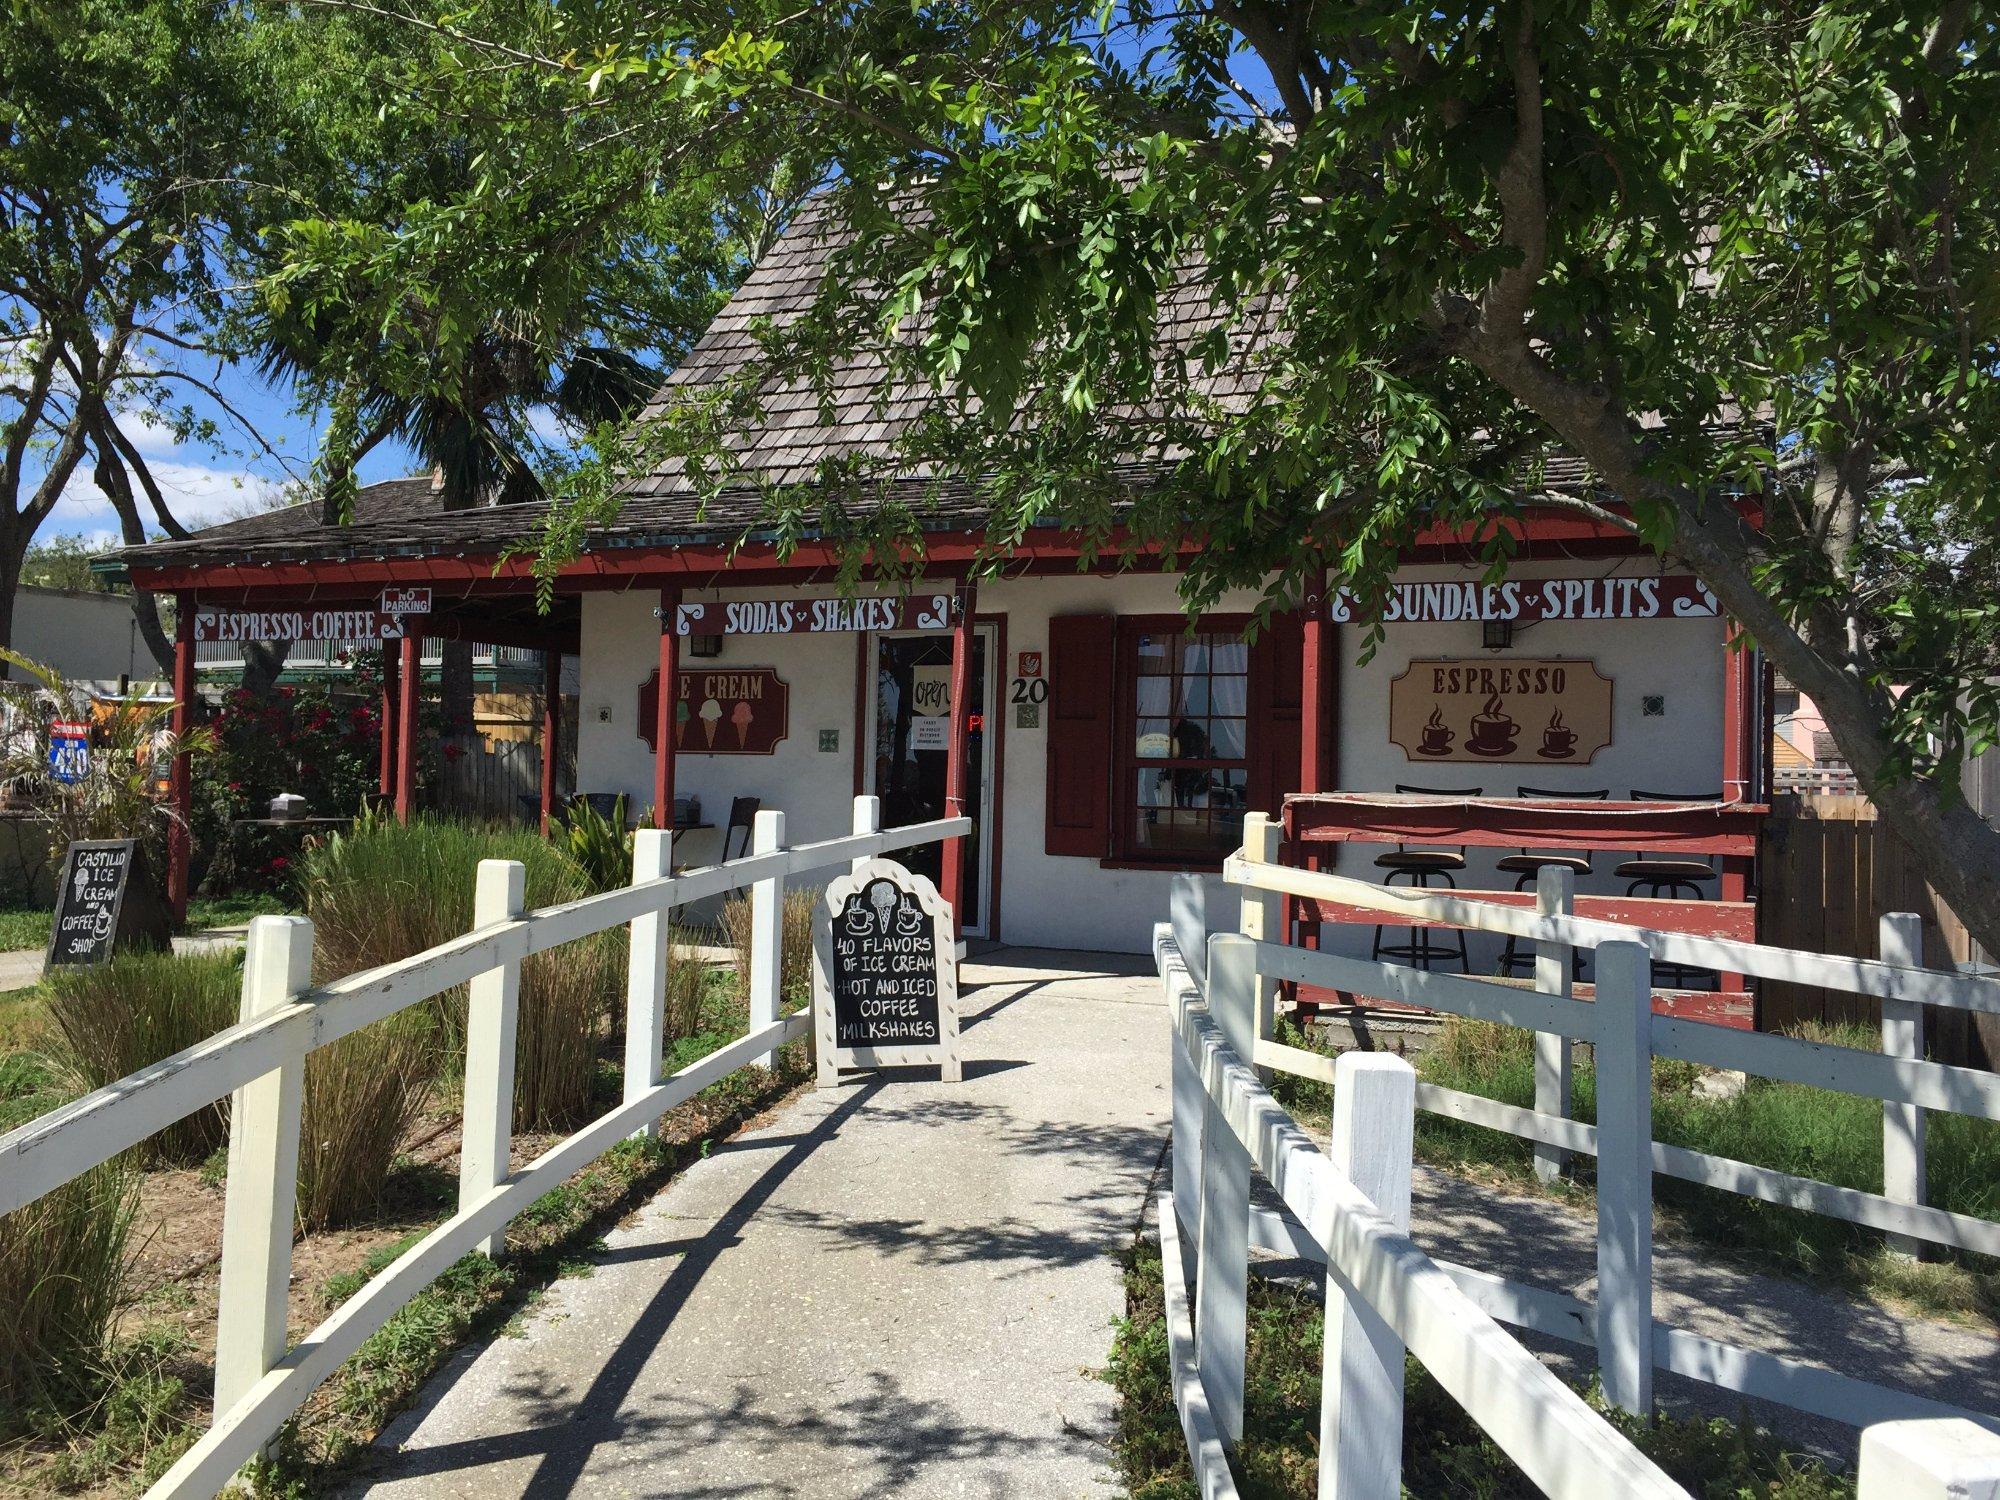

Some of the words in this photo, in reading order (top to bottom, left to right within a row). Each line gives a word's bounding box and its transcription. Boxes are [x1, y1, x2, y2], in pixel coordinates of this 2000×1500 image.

[398, 590, 416, 601] NO
[1383, 582, 1521, 621] SUNDAES
[1541, 578, 1660, 619] SPLITS
[385, 600, 428, 611] PARKING
[724, 601, 795, 634] SODAS
[810, 598, 896, 632] SHAKES
[218, 612, 303, 641] ESPRESSO
[312, 611, 376, 640] COFFEE
[704, 675, 763, 700] CREAM
[1433, 667, 1567, 695] ESPRESSO
[1011, 678, 1049, 704] 20
[77, 851, 125, 867] CASTILLO
[94, 868, 115, 882] ICE
[84, 887, 118, 901] CREAM
[62, 914, 96, 931] COFFEE
[68, 938, 96, 954] SHOP
[837, 938, 856, 955] 40
[862, 937, 932, 953] FLAVORS
[843, 954, 858, 971] OF
[861, 955, 888, 972] ICE
[891, 956, 936, 972] CREAM
[842, 978, 871, 995] HOT
[875, 980, 900, 996] AND
[901, 979, 936, 997] ICED
[860, 999, 919, 1017] COFFEE
[842, 1021, 936, 1039] MILKSHAKES
